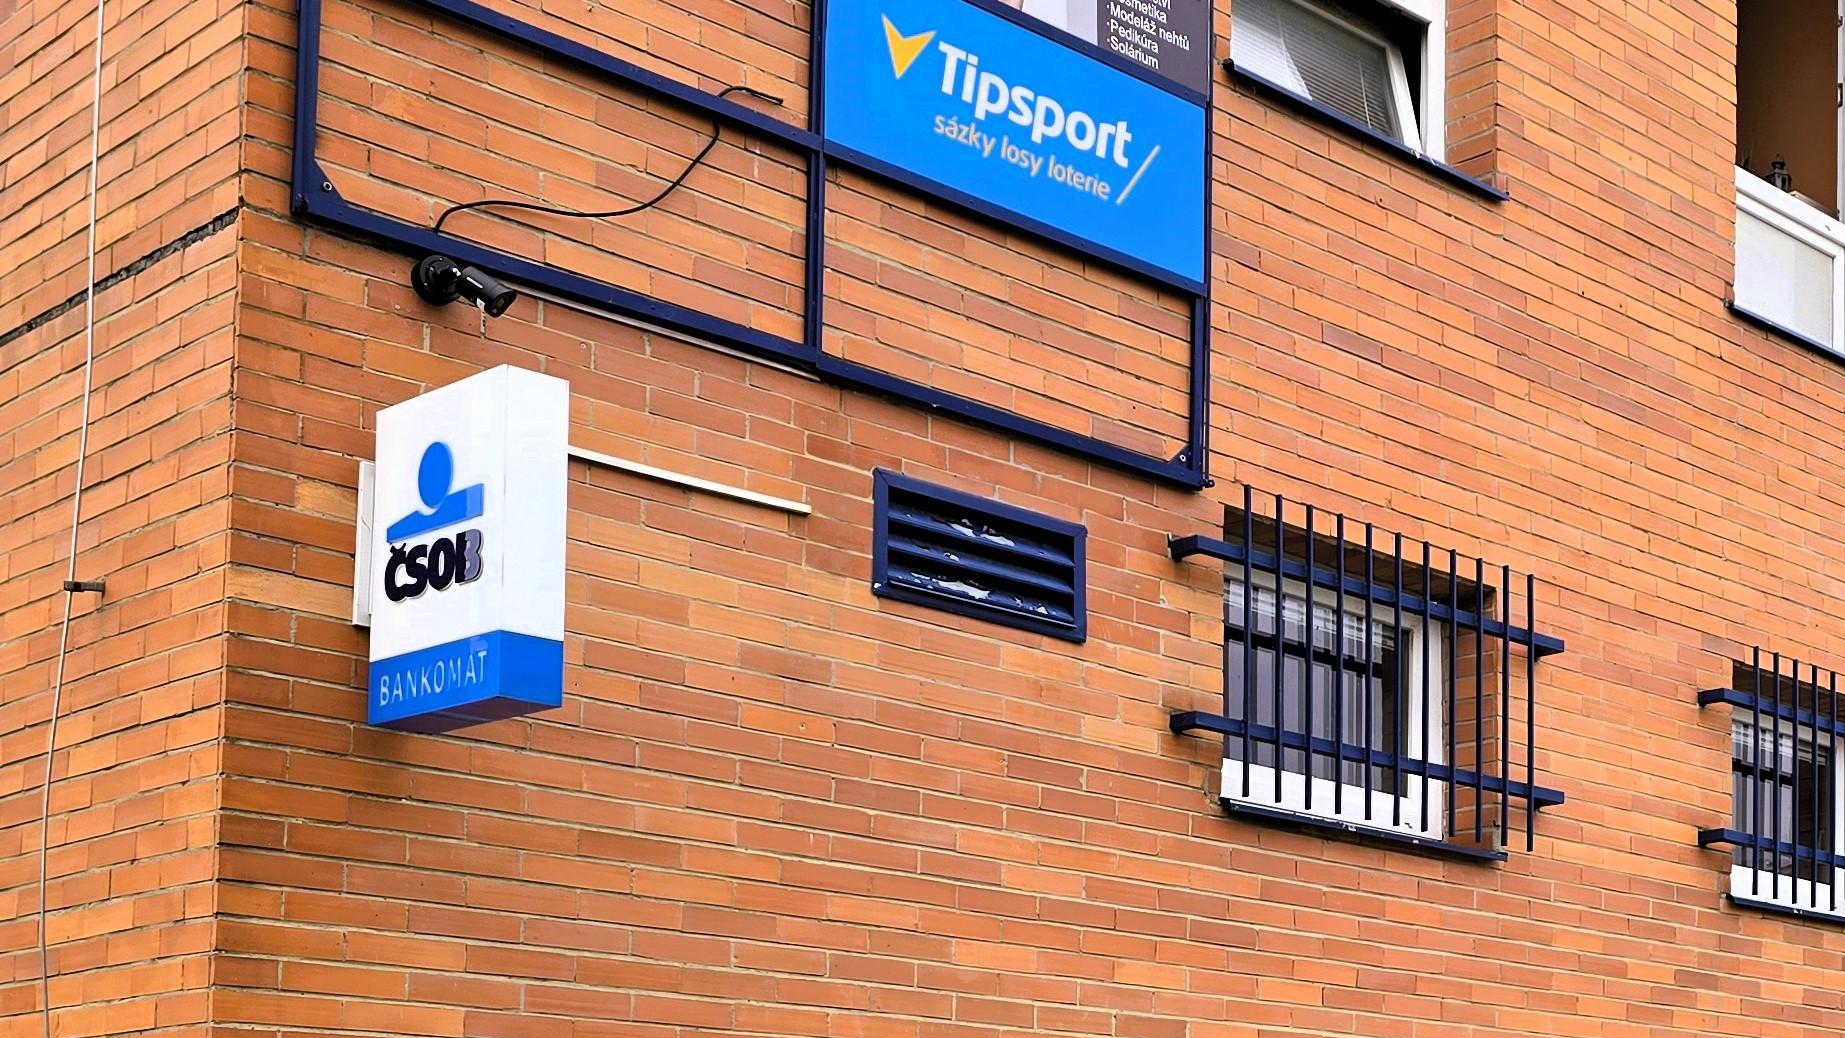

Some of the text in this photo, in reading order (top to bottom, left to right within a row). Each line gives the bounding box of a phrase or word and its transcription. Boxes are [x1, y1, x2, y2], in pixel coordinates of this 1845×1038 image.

[1110, 2, 1190, 51] Modeláž nehtů
[1110, 18, 1159, 53] Pedikúra
[1110, 35, 1159, 70] Solárium
[938, 41, 1132, 168] Tipsport
[934, 115, 1111, 200] sázky losy loterie
[384, 529, 483, 602] ČSOB
[380, 650, 488, 706] BANKOMAT
